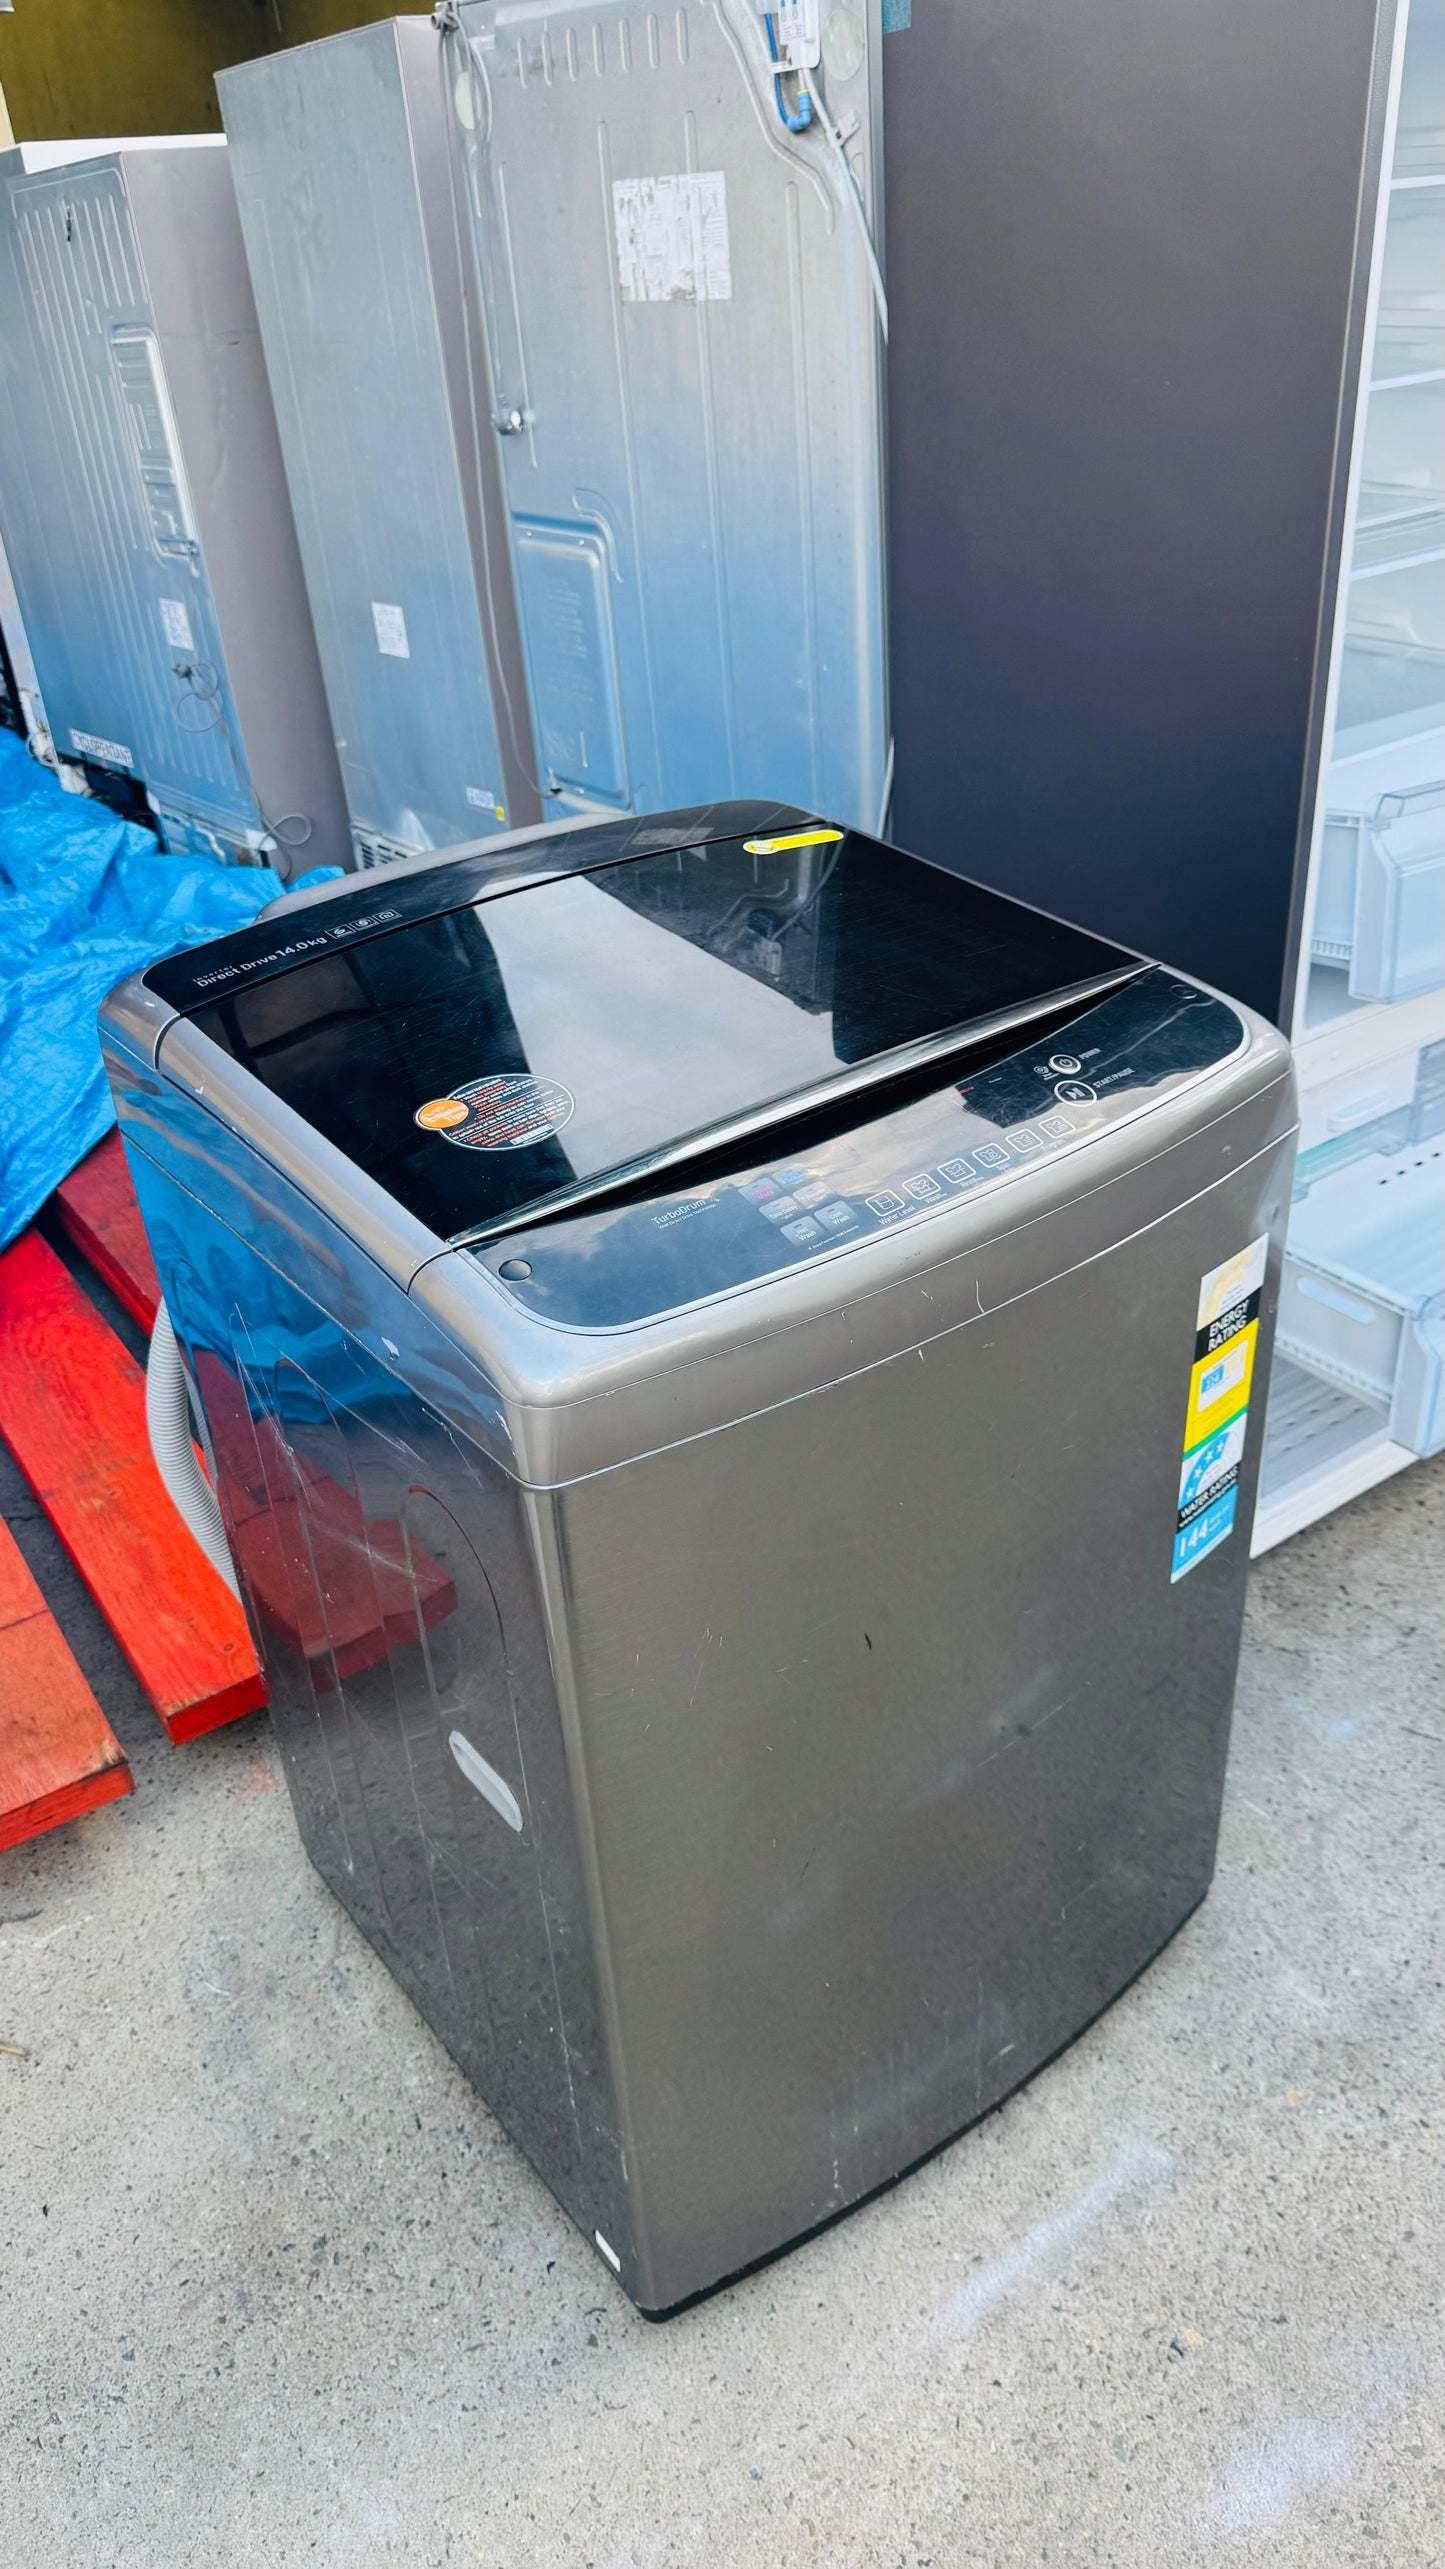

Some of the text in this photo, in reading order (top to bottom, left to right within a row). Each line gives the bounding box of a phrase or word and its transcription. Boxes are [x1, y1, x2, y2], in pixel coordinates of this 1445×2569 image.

[196, 967, 242, 988] Direct
[241, 953, 278, 972] Drive
[1078, 1047, 1102, 1061] POWER
[1092, 1067, 1137, 1089] START/PAUSE
[650, 1198, 708, 1226] TurboDrum
[924, 1192, 942, 1204] Wash
[878, 1204, 916, 1226] Water Level
[1209, 1299, 1250, 1338] ENERGY
[1208, 1314, 1248, 1352] RATING
[1181, 1490, 1210, 1519] WATER
[1179, 1518, 1209, 1558] 144
